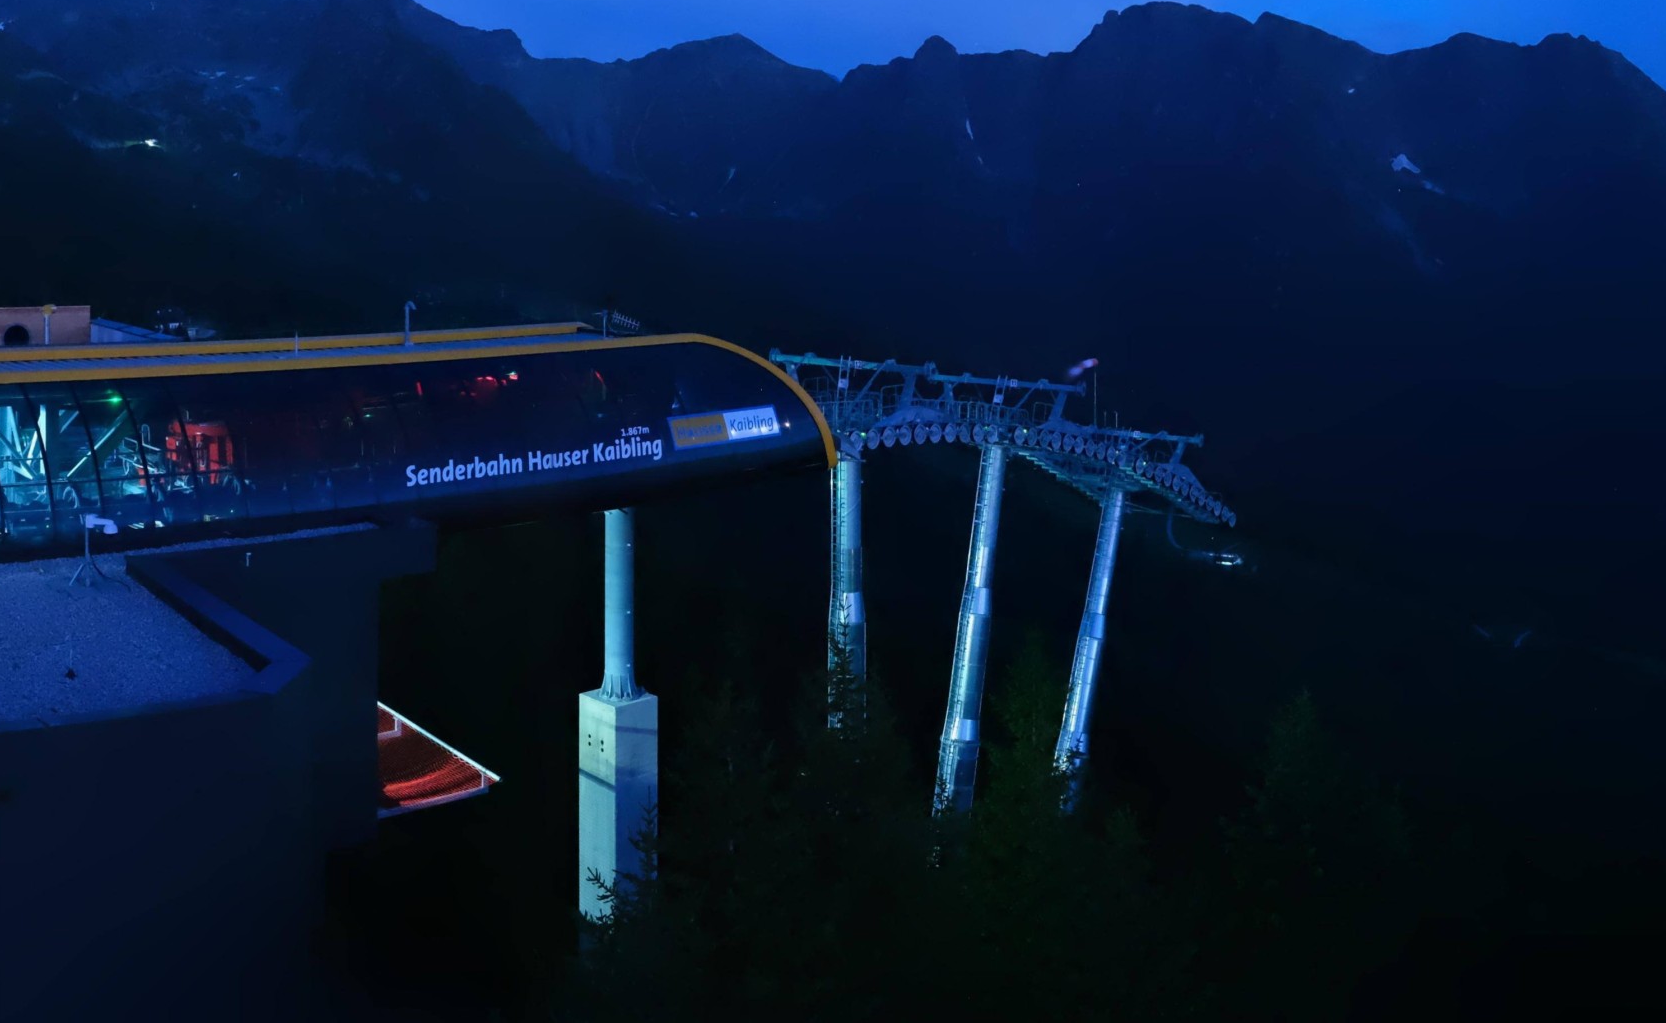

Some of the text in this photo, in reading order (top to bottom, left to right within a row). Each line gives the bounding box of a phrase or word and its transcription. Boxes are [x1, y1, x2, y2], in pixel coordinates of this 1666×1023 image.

[621, 426, 650, 437] 1.867m
[730, 417, 774, 433] Kaibling
[406, 437, 662, 487] Senderbahn Hauser Kaibling
